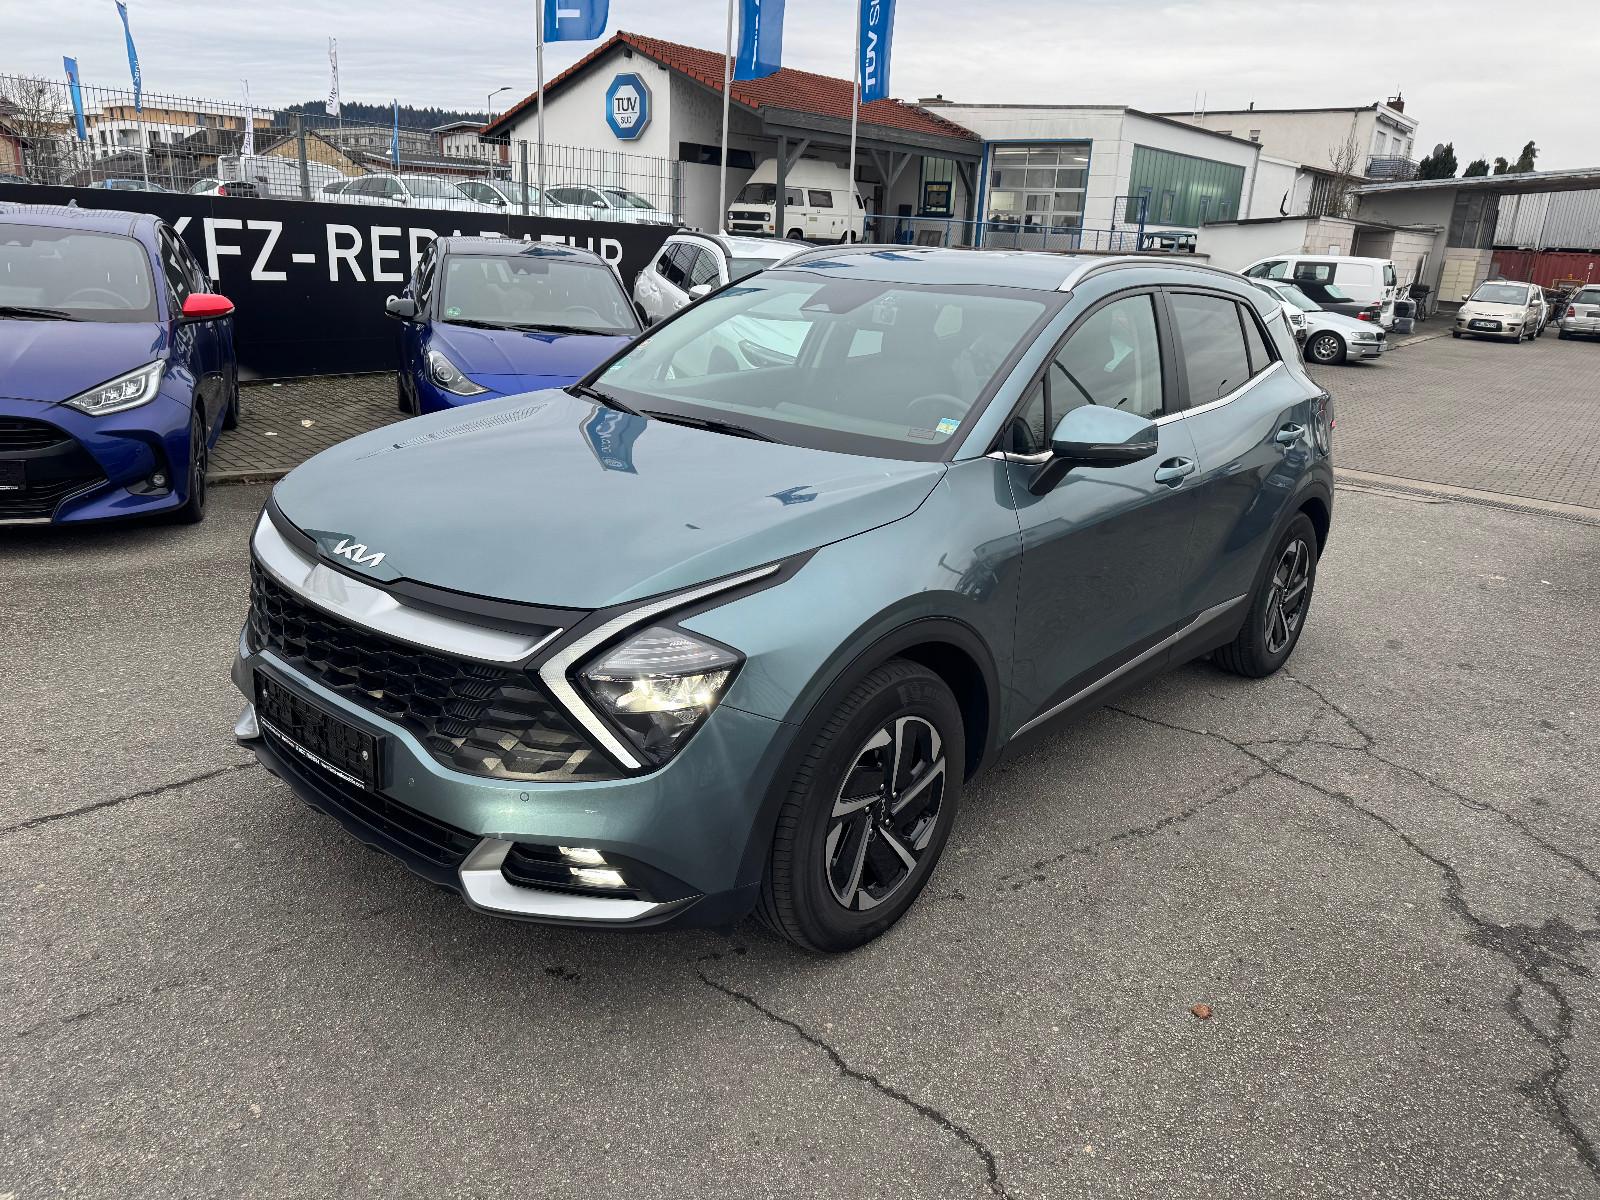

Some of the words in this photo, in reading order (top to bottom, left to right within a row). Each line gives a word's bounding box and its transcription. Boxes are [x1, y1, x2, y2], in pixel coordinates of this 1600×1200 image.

[865, 30, 878, 94] TÜV
[615, 97, 637, 112] TÜV
[333, 538, 386, 568] KIA
